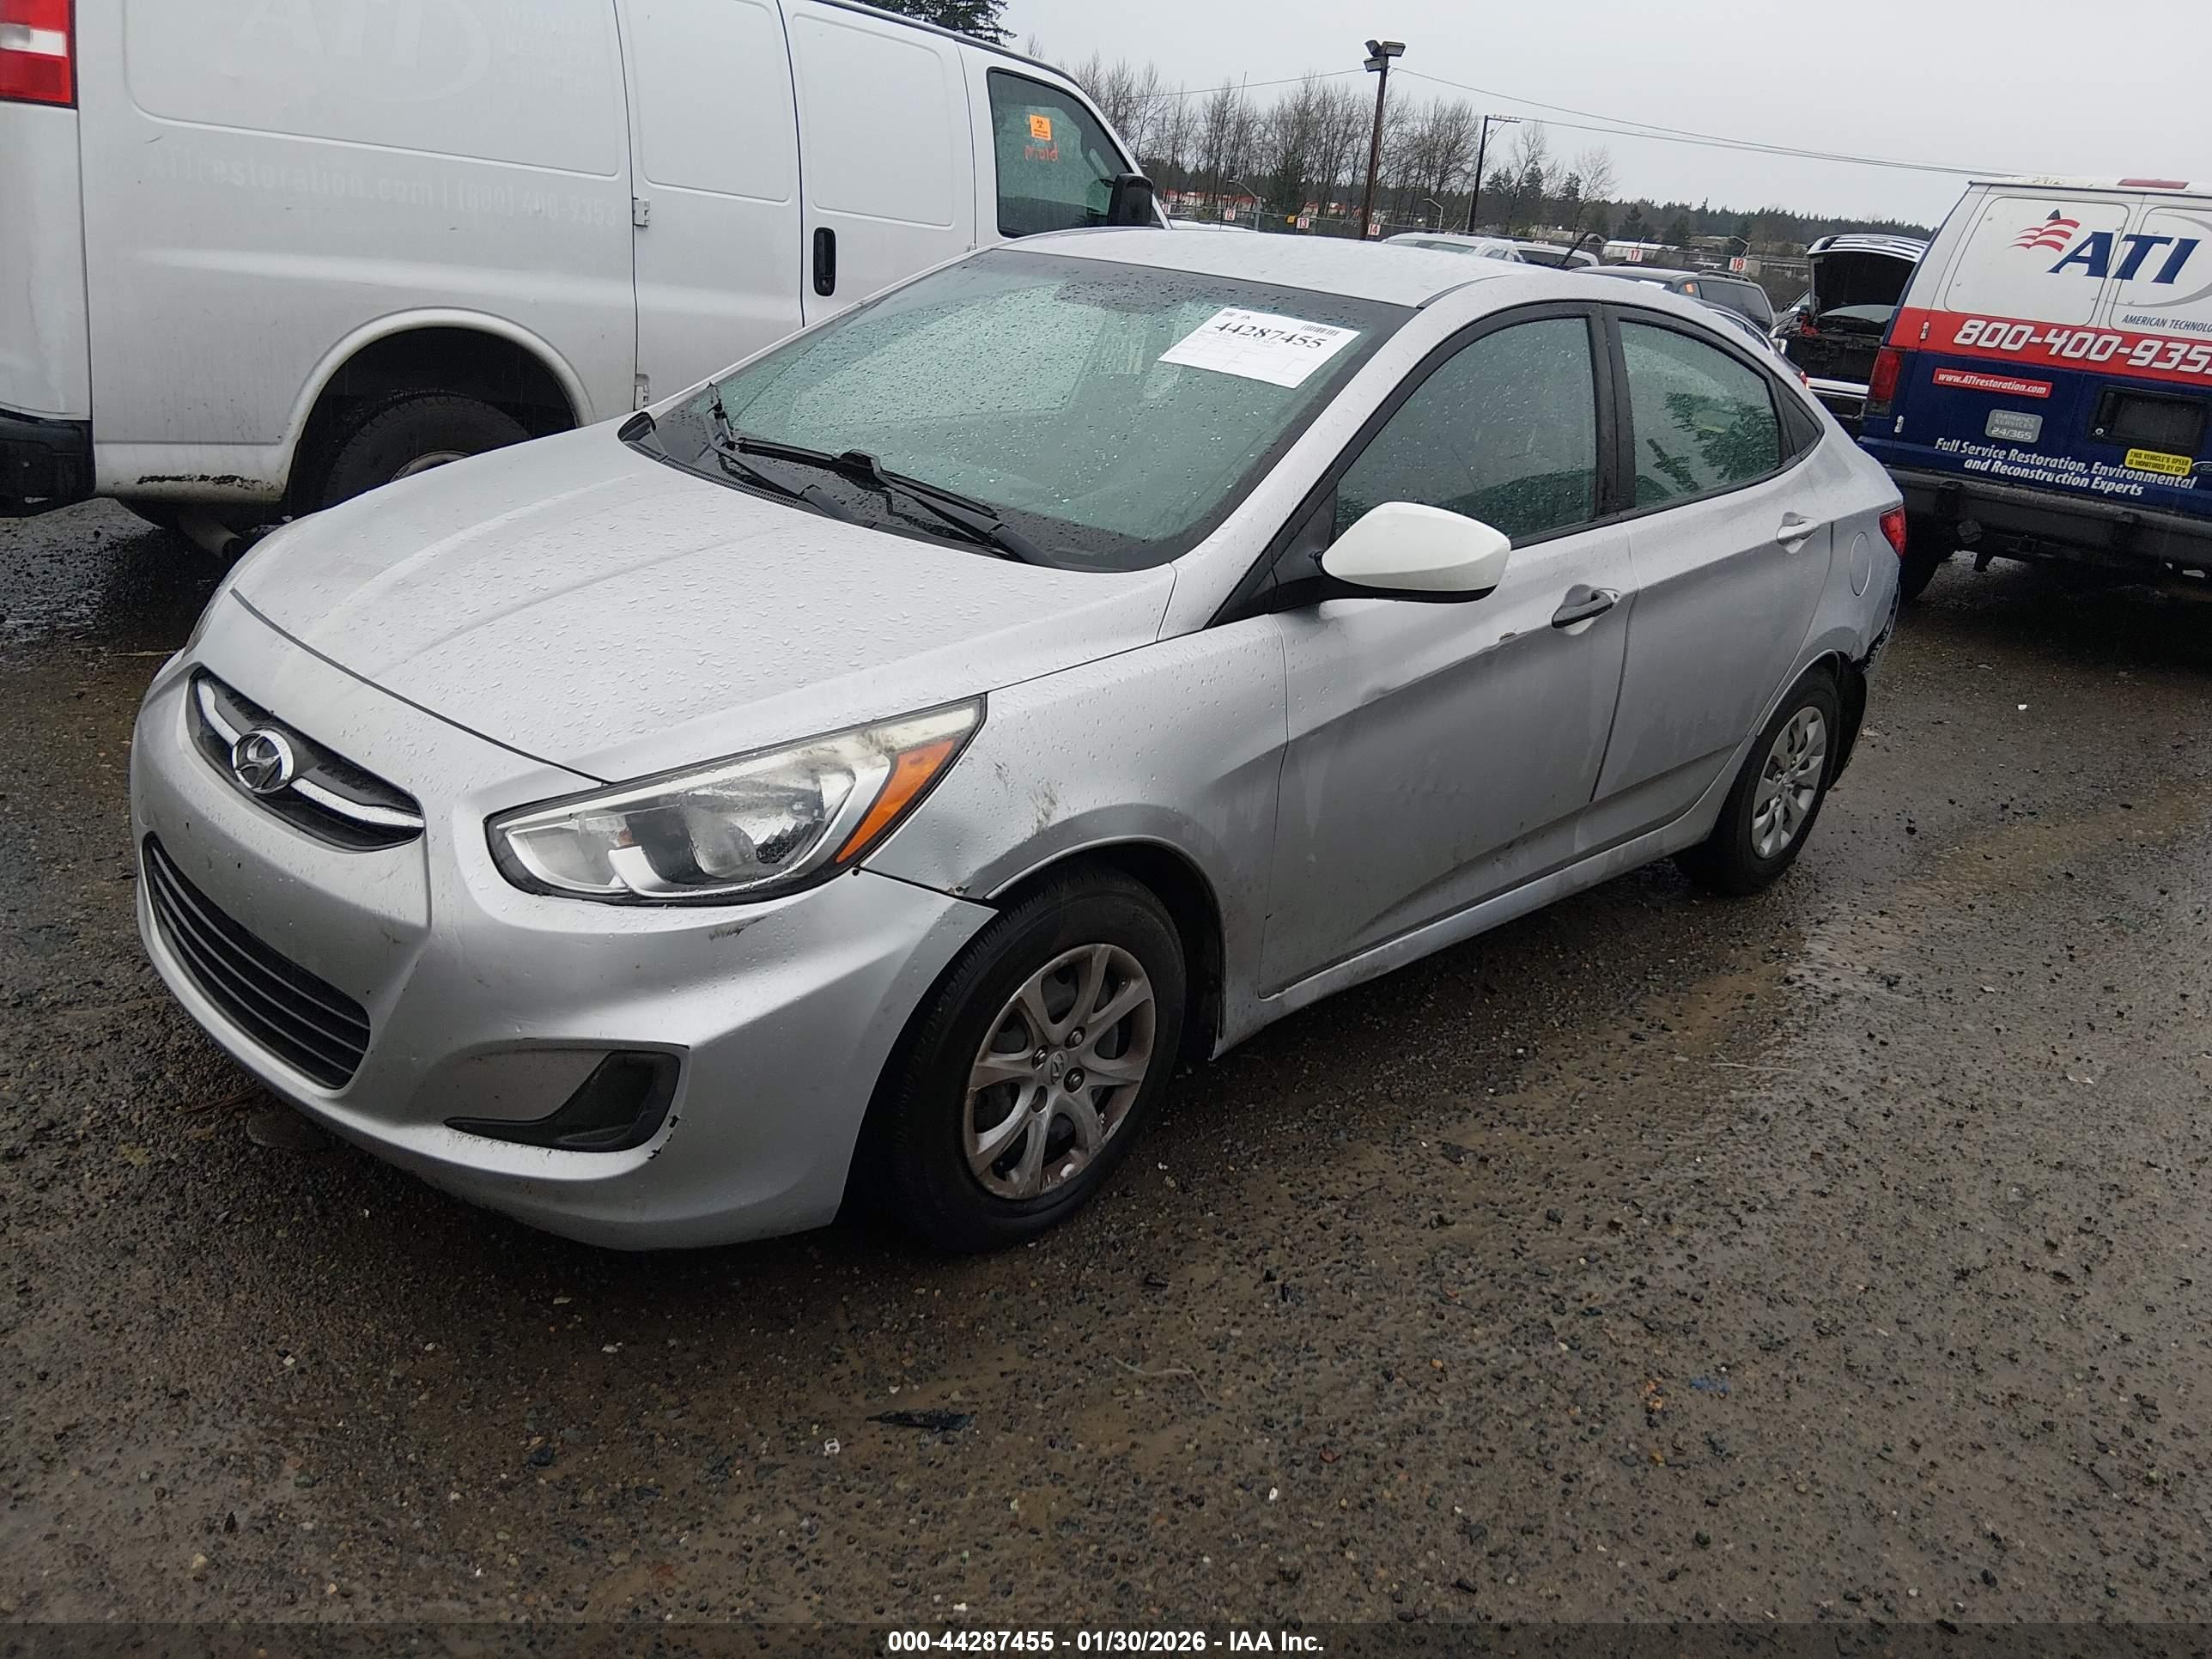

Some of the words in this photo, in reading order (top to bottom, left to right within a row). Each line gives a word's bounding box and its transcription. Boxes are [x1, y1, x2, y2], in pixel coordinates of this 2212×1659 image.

[458, 178, 514, 216] (800)
[523, 191, 616, 226] 400-9353
[1226, 210, 1235, 220] 12
[1299, 217, 1308, 228] 13
[1370, 224, 1379, 235] 14
[1631, 250, 1640, 261] 17
[1732, 258, 1744, 270] 18
[2046, 231, 2201, 285] ATI
[2122, 314, 2168, 329] AMERICAN
[1214, 322, 1328, 349] 44287455
[1953, 319, 2212, 375] 800-400-935
[1938, 373, 2047, 394] www.ATIrestoration.com
[1990, 427, 2033, 440] 24/365
[1935, 438, 1960, 453] Full
[1960, 441, 2007, 459] Service
[2008, 448, 2089, 474] Restoration,
[2091, 462, 2198, 489] Environmental
[1964, 459, 1991, 471] and
[1991, 461, 2090, 487] Reconstruction
[2091, 477, 2144, 495] Experts
